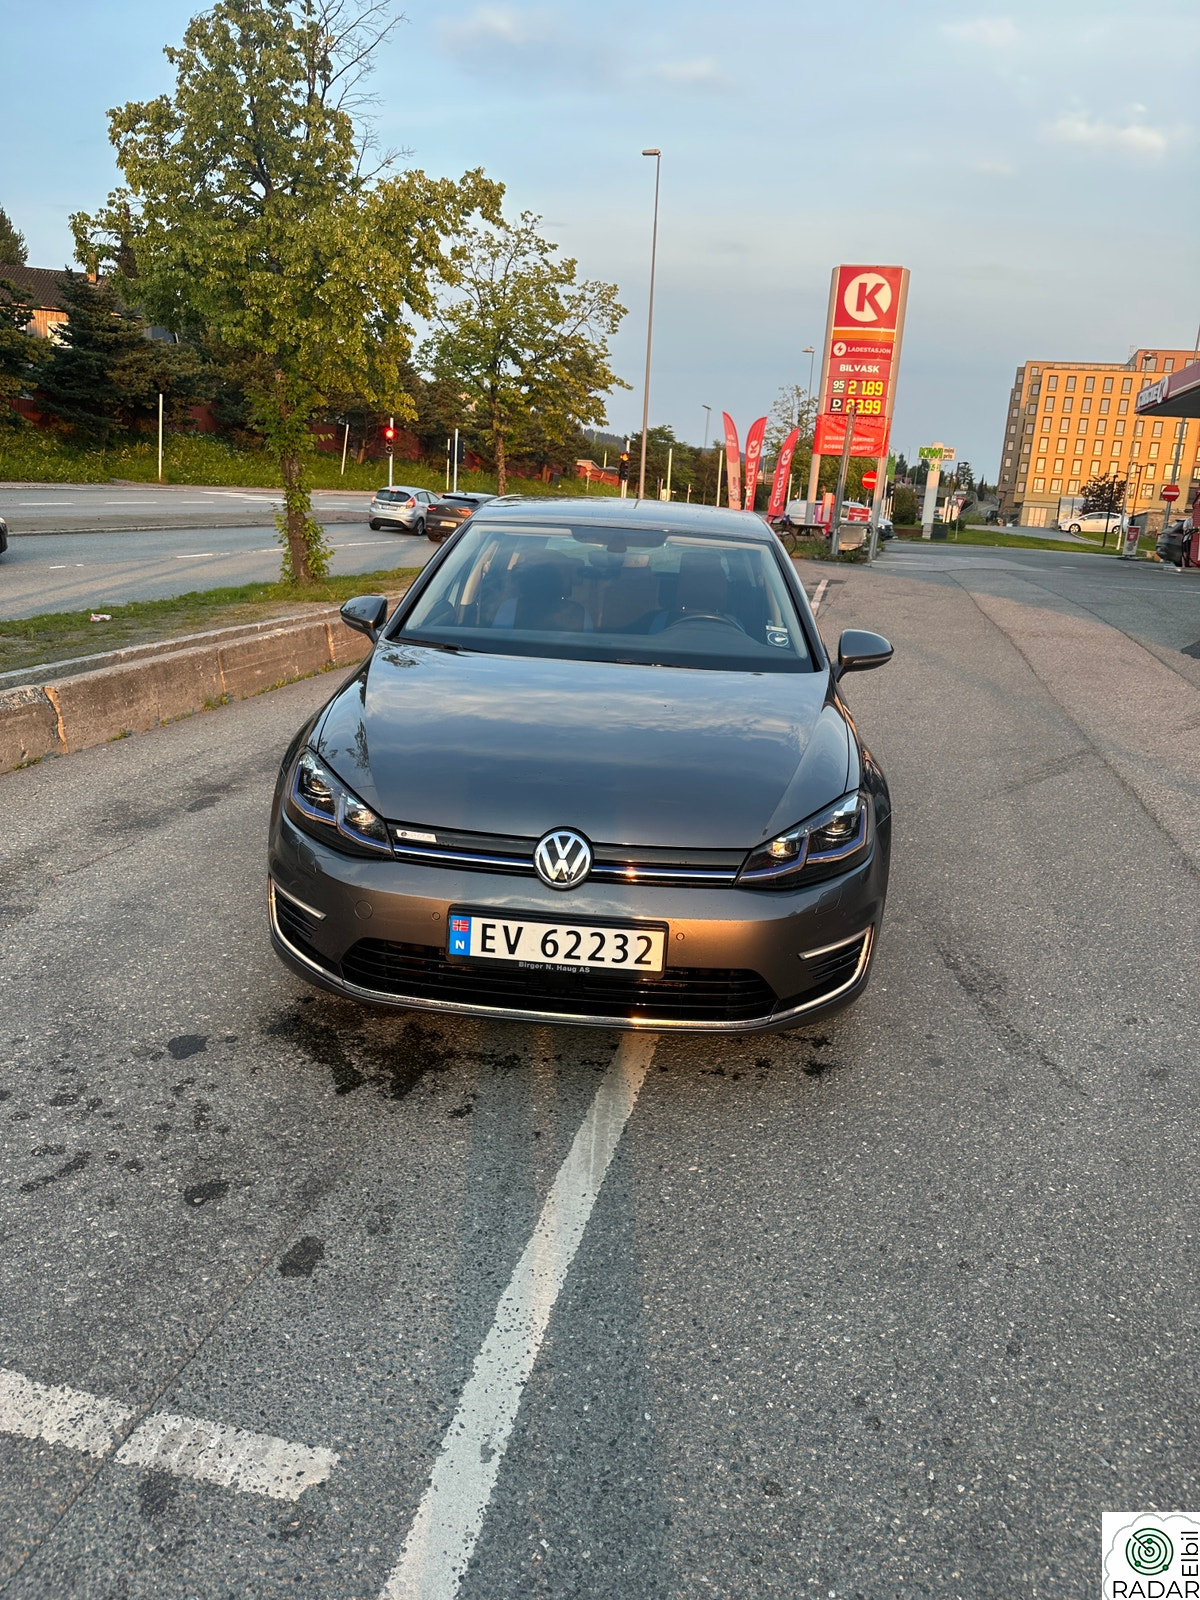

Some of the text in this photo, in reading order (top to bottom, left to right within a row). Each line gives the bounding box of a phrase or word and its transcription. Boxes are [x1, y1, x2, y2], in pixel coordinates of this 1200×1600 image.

[847, 346, 891, 354] LADESTASJON
[839, 363, 880, 373] BILVASK
[833, 380, 845, 389] 95
[832, 399, 842, 407] D
[919, 447, 943, 459] KIWI
[773, 467, 786, 507] CIRCLE
[455, 940, 465, 950] N
[480, 923, 654, 965] EV 62232
[518, 961, 543, 970] Birger
[556, 965, 577, 973] Haug
